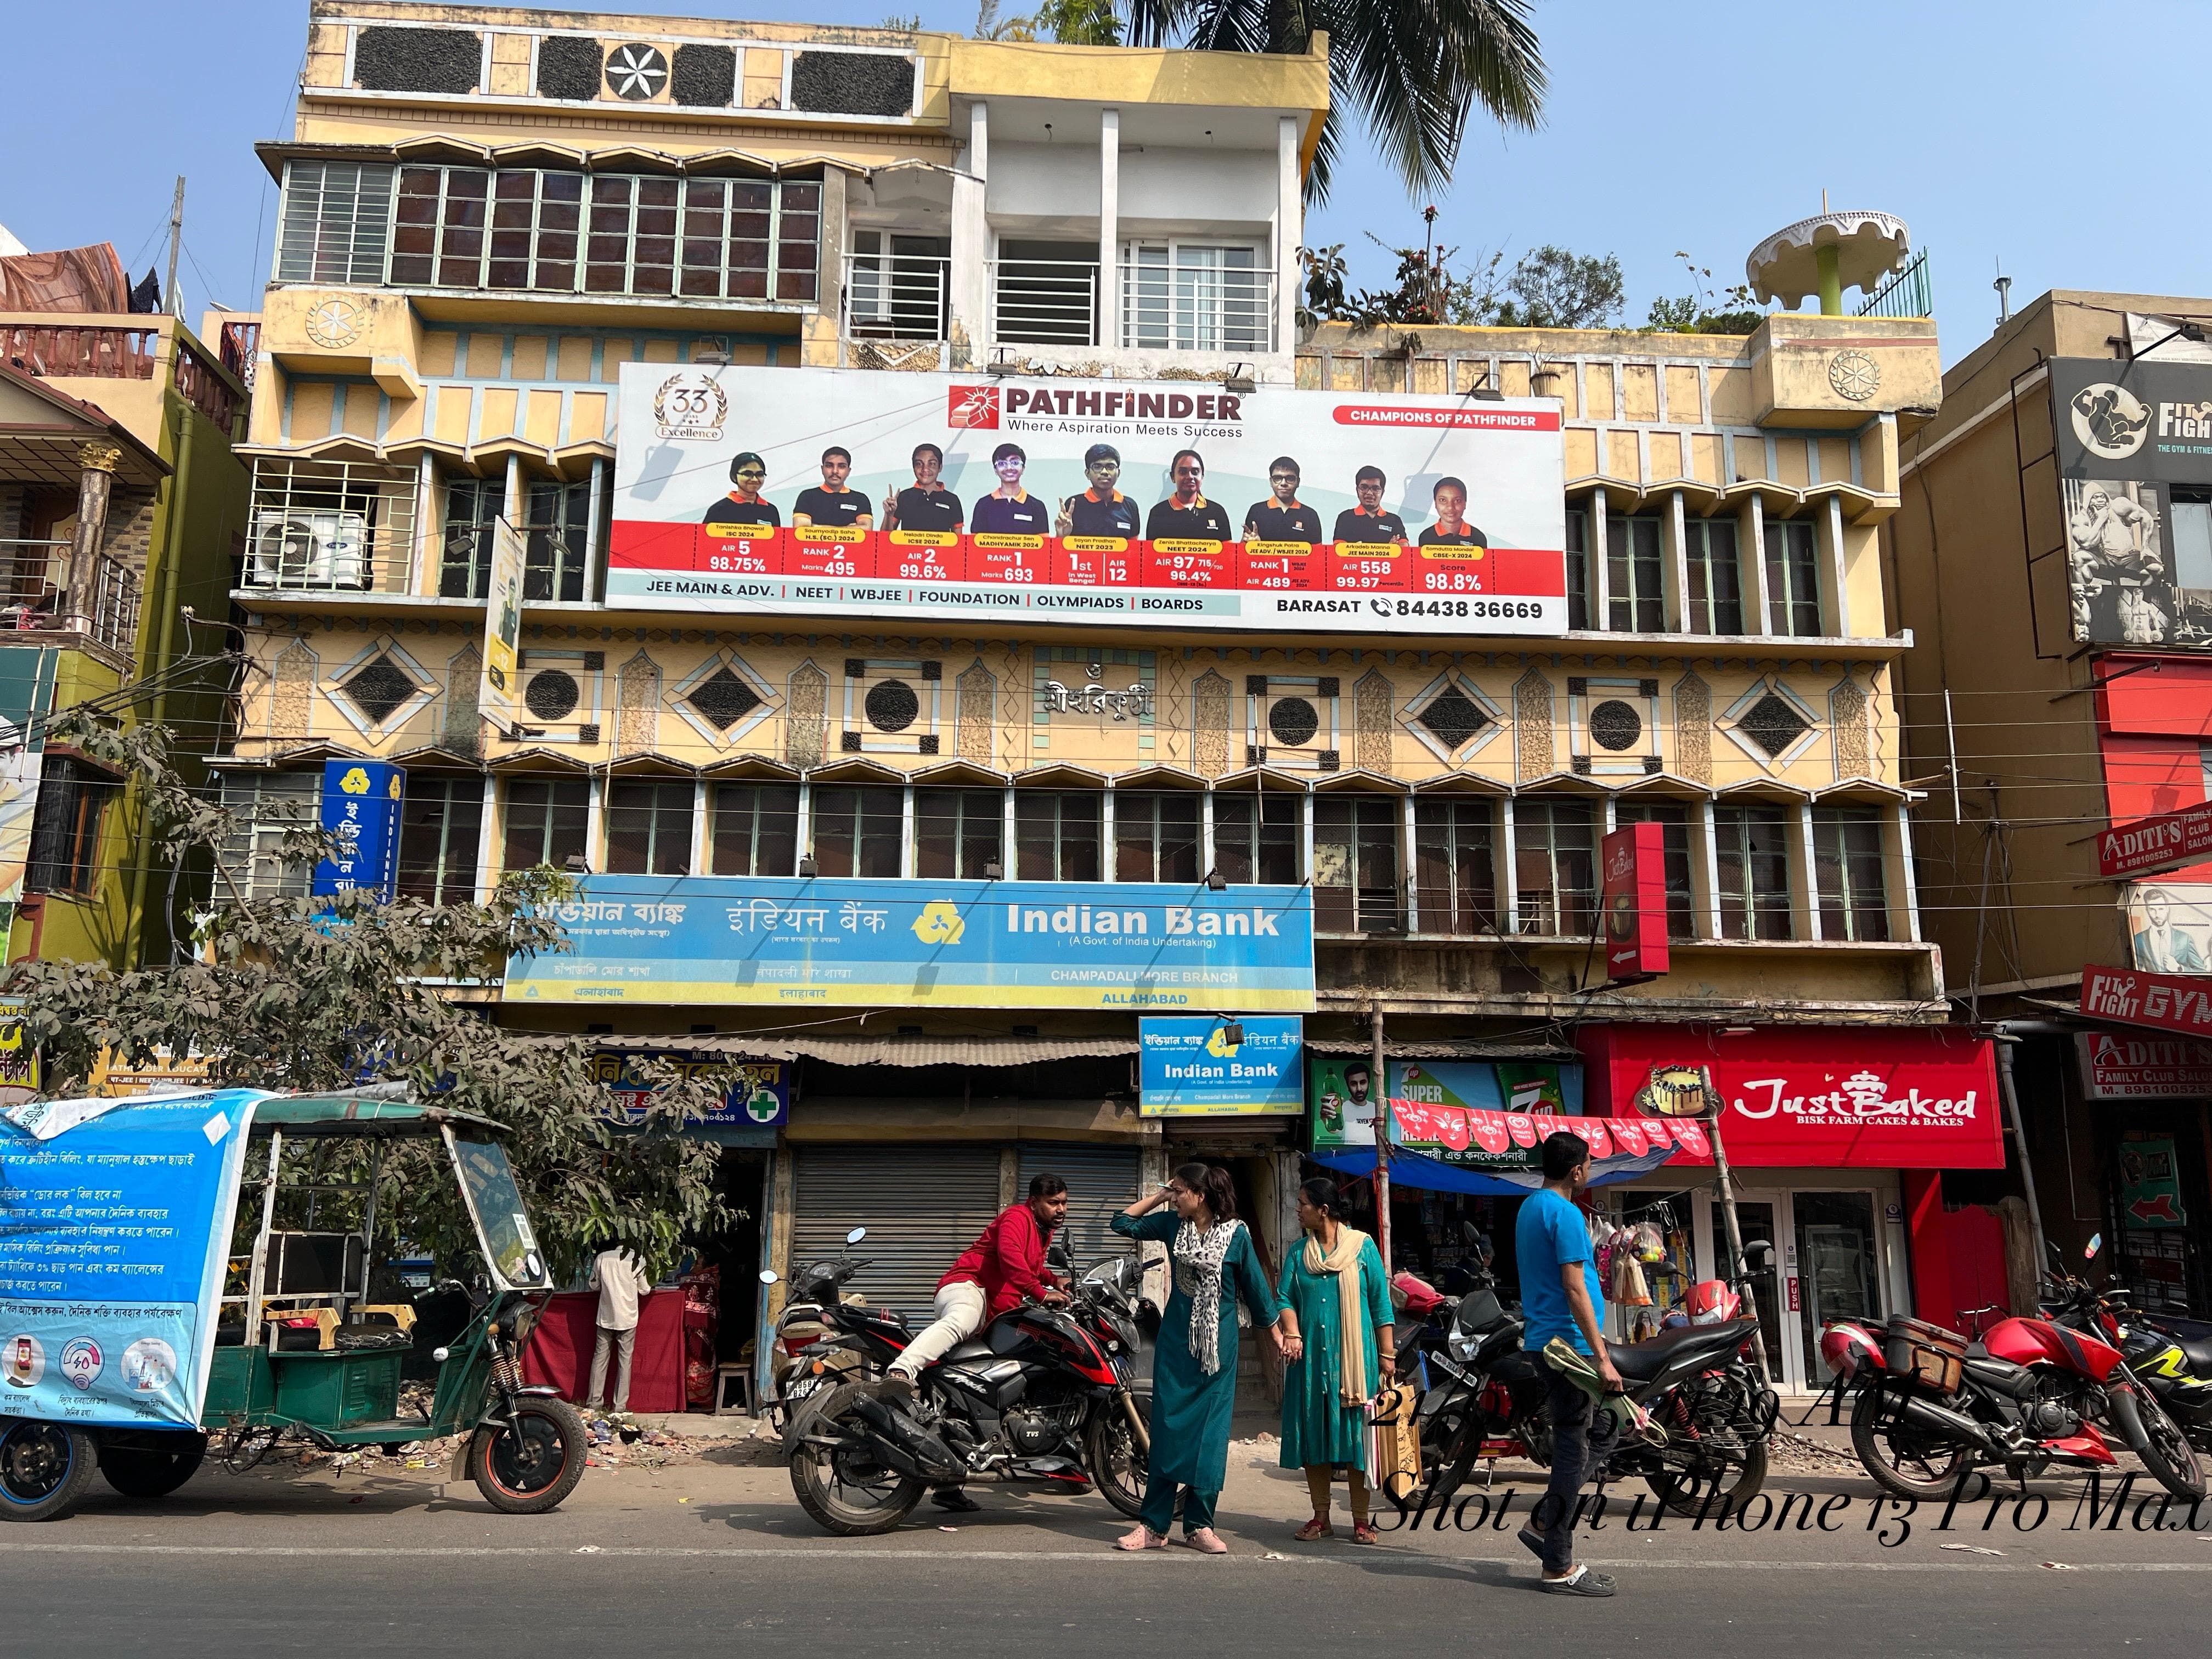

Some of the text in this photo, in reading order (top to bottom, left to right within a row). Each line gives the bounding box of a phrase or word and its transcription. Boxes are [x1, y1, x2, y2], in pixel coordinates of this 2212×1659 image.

[673, 388, 708, 413] 33
[1351, 409, 1537, 427] CHAMPIONS OF PATHFINDER
[661, 426, 718, 439] Excellence
[1008, 419, 1243, 438] Where Aspiration Meets Success
[2157, 444, 2192, 454] THE GYM &
[738, 540, 751, 555] 5
[803, 545, 845, 560] RANK 2
[924, 549, 936, 563] 2
[987, 552, 1022, 566] RANK 1
[1069, 554, 1092, 571] 1st
[1173, 556, 1195, 569] 97
[710, 556, 766, 572] 98.75%
[824, 561, 855, 575] 495
[900, 563, 946, 579] 99.6%
[1281, 558, 1289, 573] 1
[1360, 561, 1391, 575] 558
[1004, 568, 1033, 582] 693
[1109, 568, 1127, 582] 12
[1170, 572, 1211, 582] 96.4%
[1425, 573, 1482, 591] 98.8%
[1262, 577, 1290, 588] 489
[1336, 577, 1379, 588] 99.97
[646, 580, 1203, 610] JEE MAIN & ADV. NEET WBJEE FOUNDATION OLYMPIADS BOARDS
[1277, 599, 1543, 619] BARASAT 84438 36669
[2183, 808, 2212, 825] FAMILY
[2188, 823, 2210, 836] CLUB
[2117, 848, 2174, 870] M. 8981005253
[726, 898, 889, 936] इंडियन बैंक
[1007, 902, 1280, 937] Indian Bank
[1069, 936, 1216, 949] (A Govt. of India Undertaking)
[1051, 970, 1238, 983] CHAMPADALI MORE BRANCH
[779, 989, 827, 1001] इलाहाबाद
[1102, 993, 1188, 1005] ALLAHABAD
[1280, 1032, 1299, 1046] बैंक
[1165, 1062, 1279, 1079] Indian Bank
[2142, 1069, 2175, 1082] CLUB
[1400, 1085, 1443, 1102] SUPER
[1797, 1116, 1964, 1126] BISK FARM CAKES & BAKES
[94, 1190, 111, 1202] হবে
[111, 1189, 122, 1200] না
[117, 1226, 145, 1238] করতে
[69, 1263, 84, 1274] পান
[1791, 1279, 1799, 1310] PUSH
